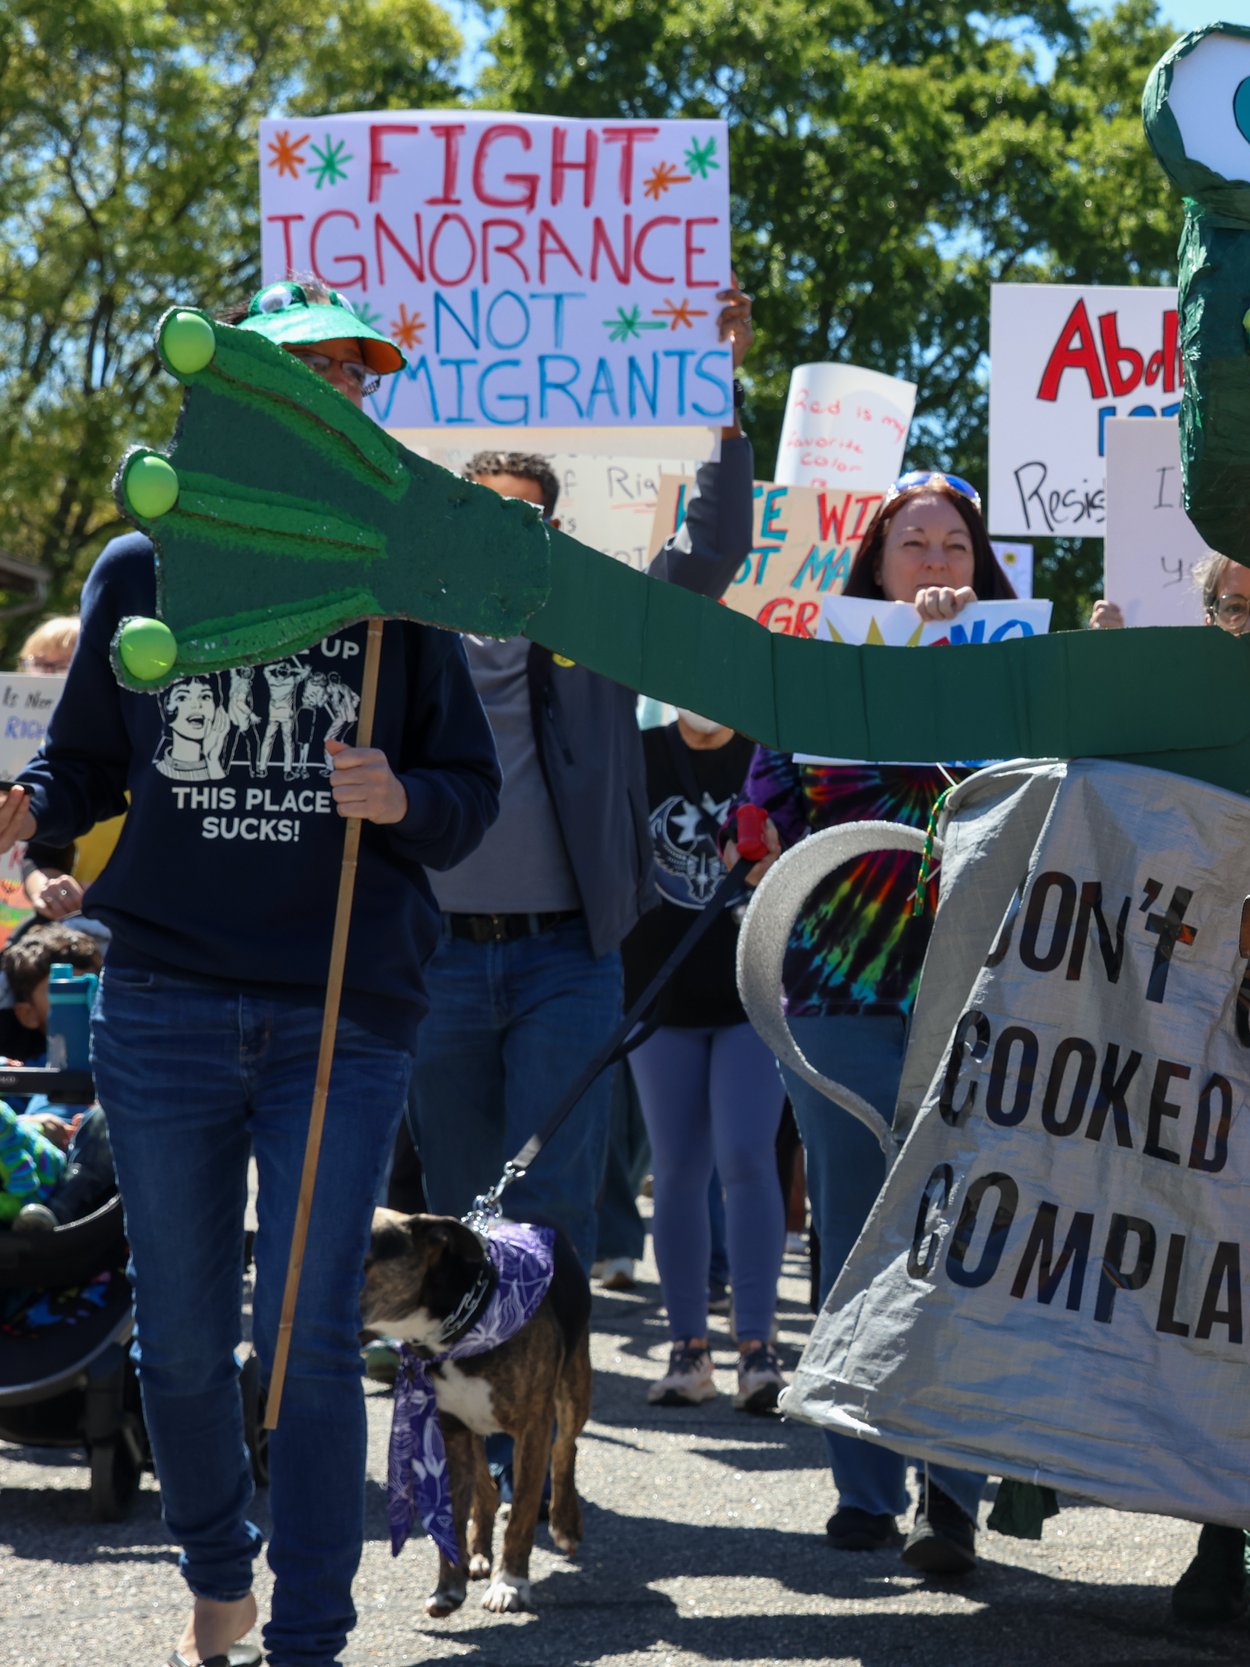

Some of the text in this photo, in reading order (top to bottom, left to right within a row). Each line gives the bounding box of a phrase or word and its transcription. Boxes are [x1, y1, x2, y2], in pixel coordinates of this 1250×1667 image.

[368, 124, 660, 215] FIGHT
[266, 209, 720, 292] IGNORANCE
[434, 288, 586, 354] NOT
[1036, 297, 1185, 402] Abol
[321, 638, 360, 660] UP
[172, 787, 331, 813] THIS PLACE
[202, 816, 300, 841] SUCKS!
[939, 1010, 1234, 1173] COOKED
